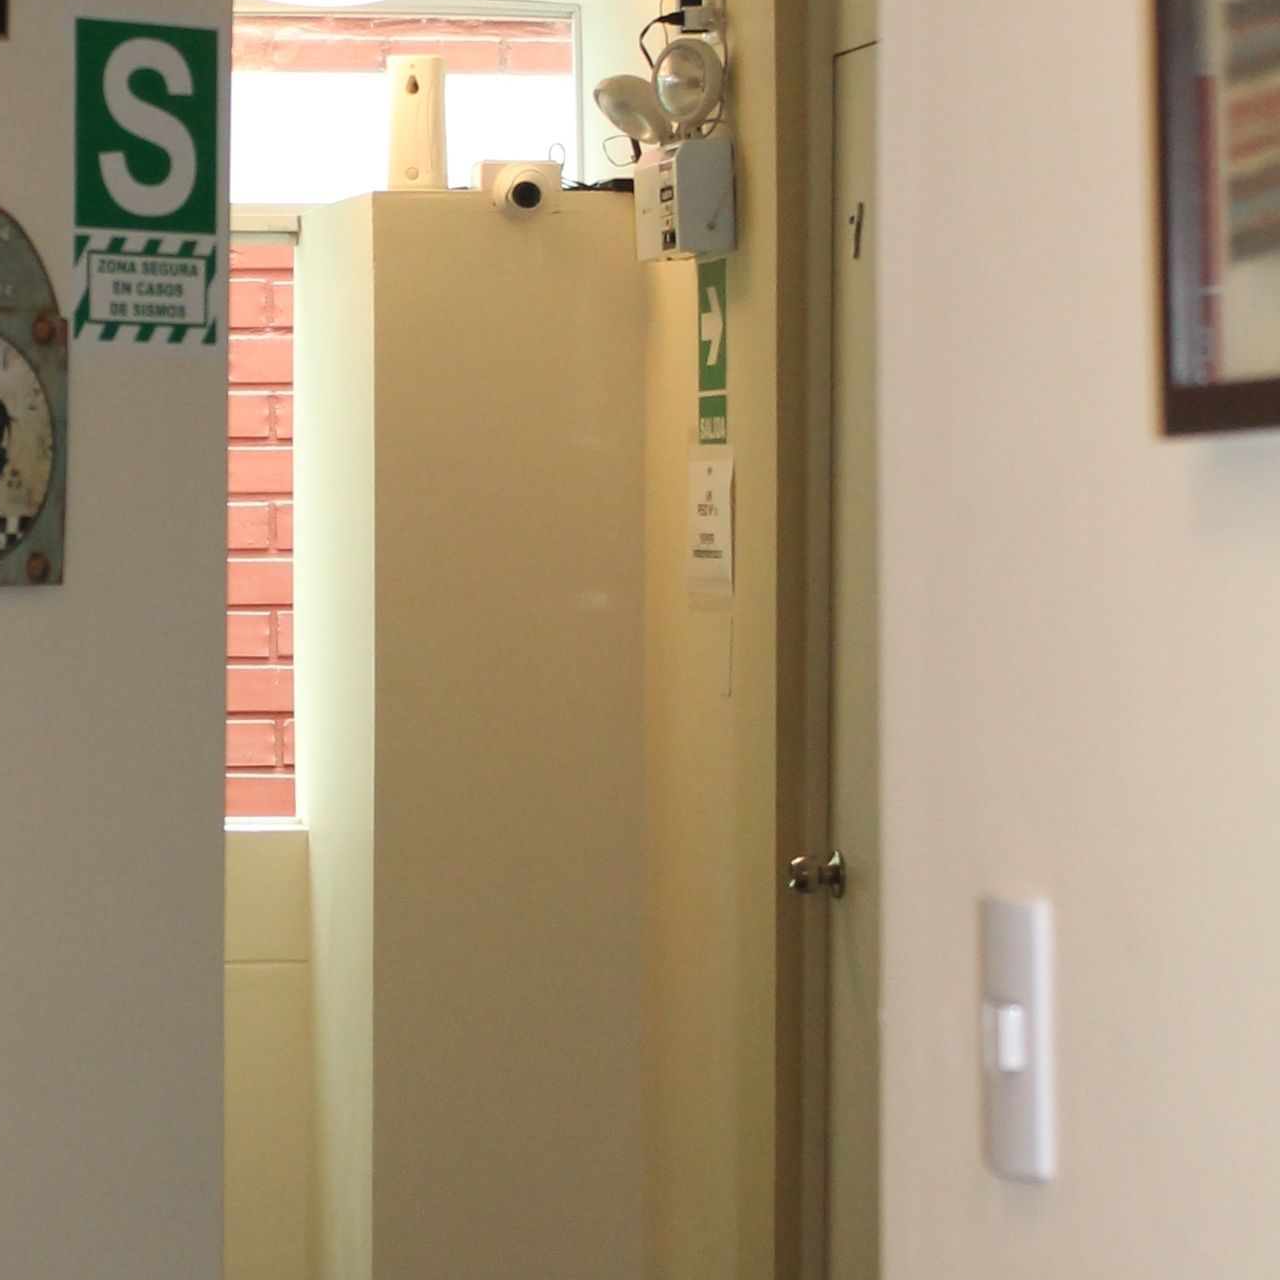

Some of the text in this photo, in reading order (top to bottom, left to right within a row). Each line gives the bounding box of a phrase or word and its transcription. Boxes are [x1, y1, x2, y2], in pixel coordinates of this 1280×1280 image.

[97, 36, 198, 218] S
[97, 259, 198, 277] ZONA SEGURA
[112, 281, 183, 298] EN CASOS
[110, 302, 187, 319] DE SISMOS
